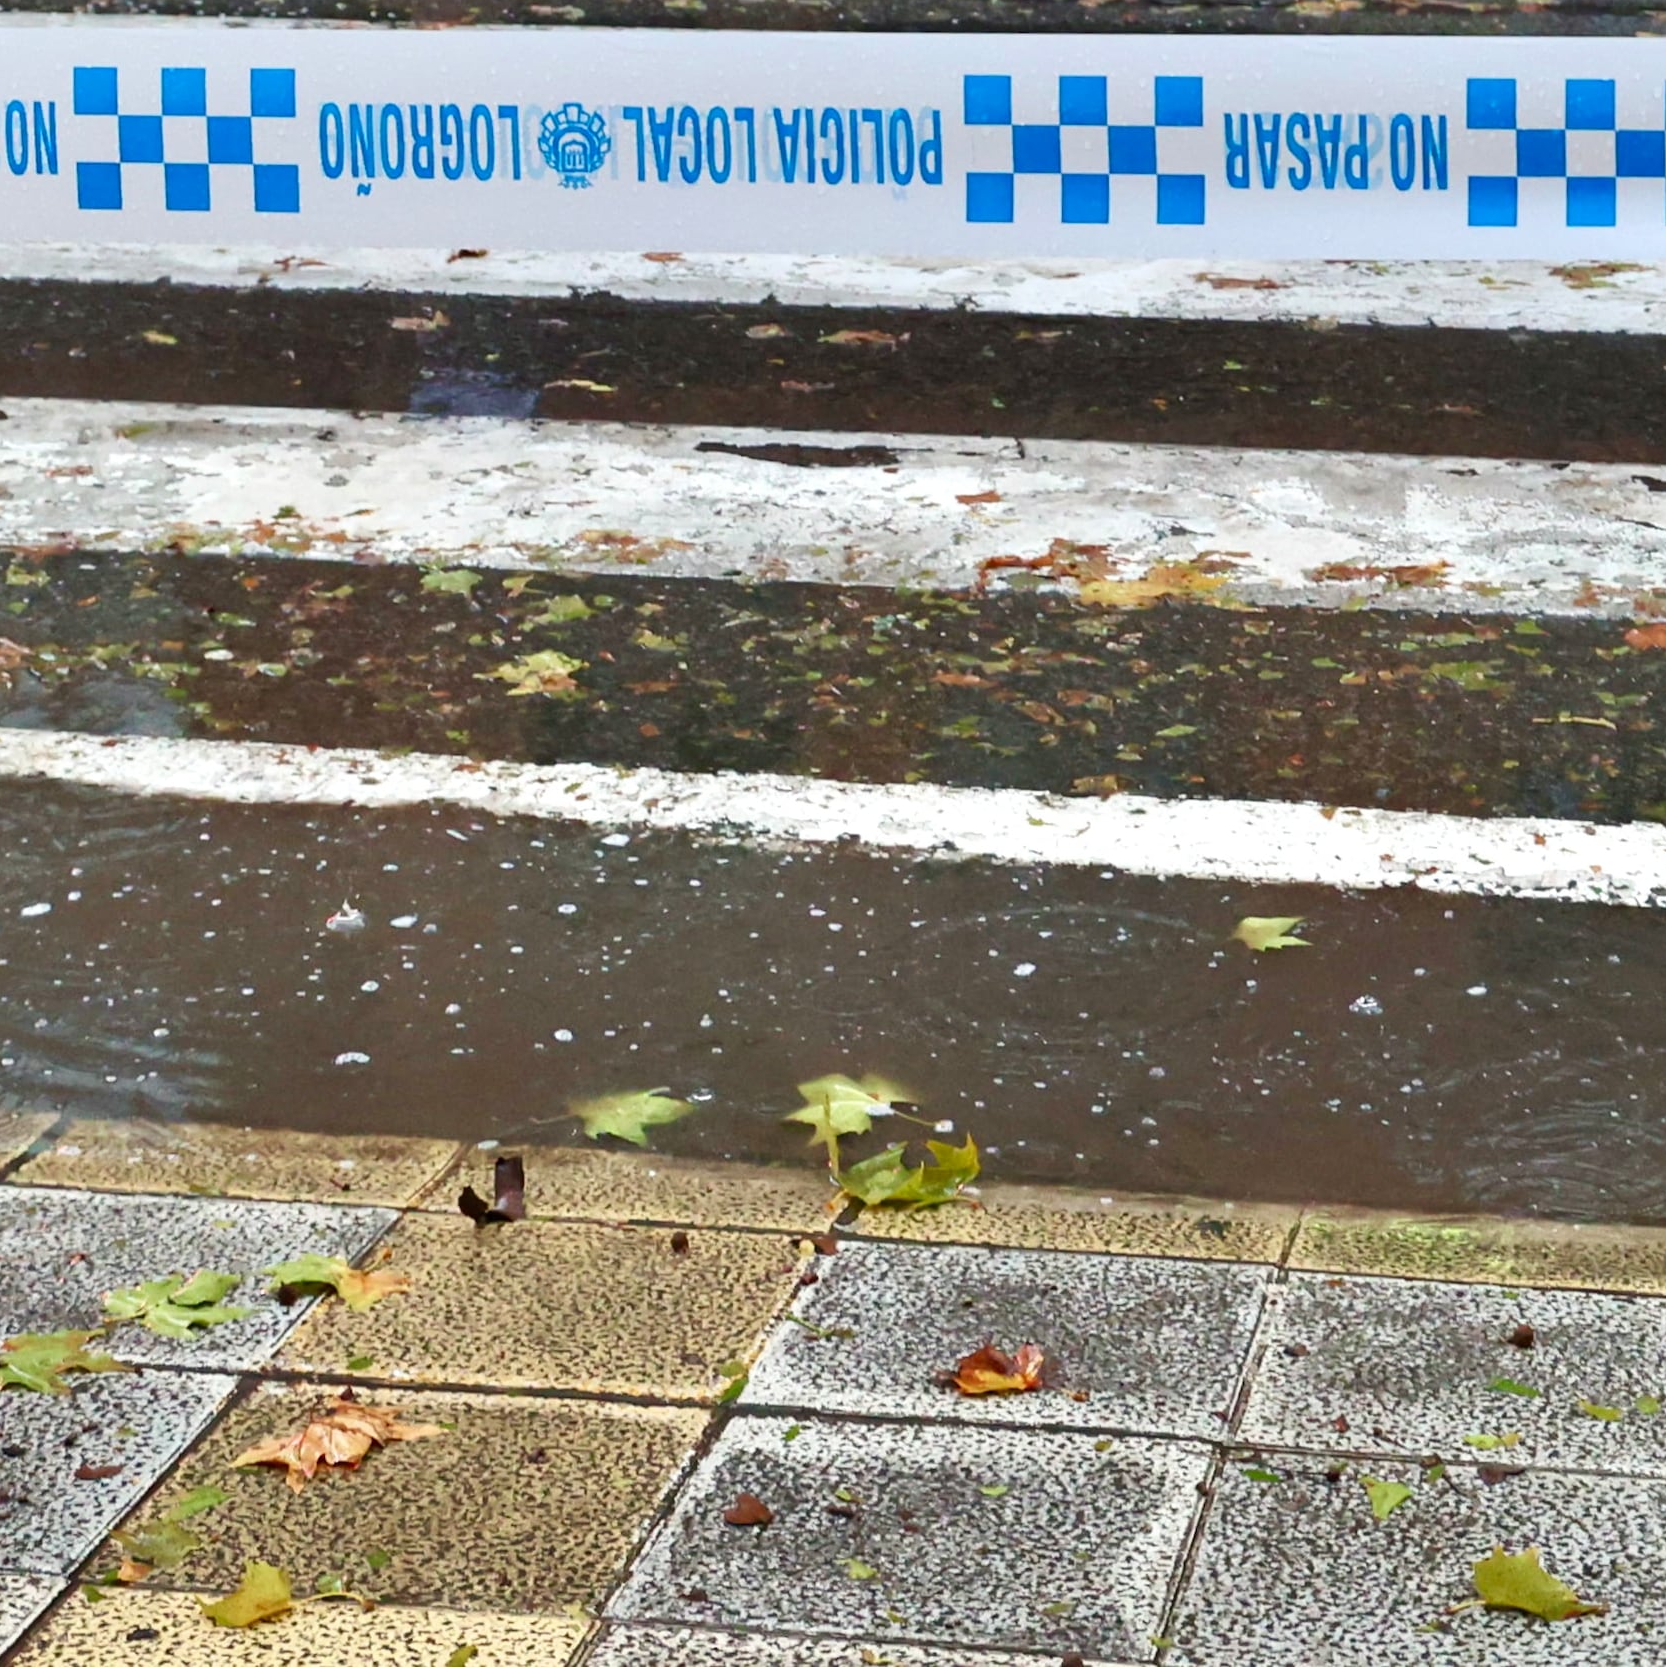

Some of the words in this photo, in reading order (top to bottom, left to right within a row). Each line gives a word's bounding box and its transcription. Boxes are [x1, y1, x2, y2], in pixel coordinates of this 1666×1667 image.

[5, 100, 58, 175] NO
[319, 103, 521, 195] LOGROÑO
[623, 105, 756, 184] LOCAL
[773, 107, 943, 186] POLICIA
[1224, 112, 1369, 191] PASAR
[1390, 113, 1448, 191] NO
